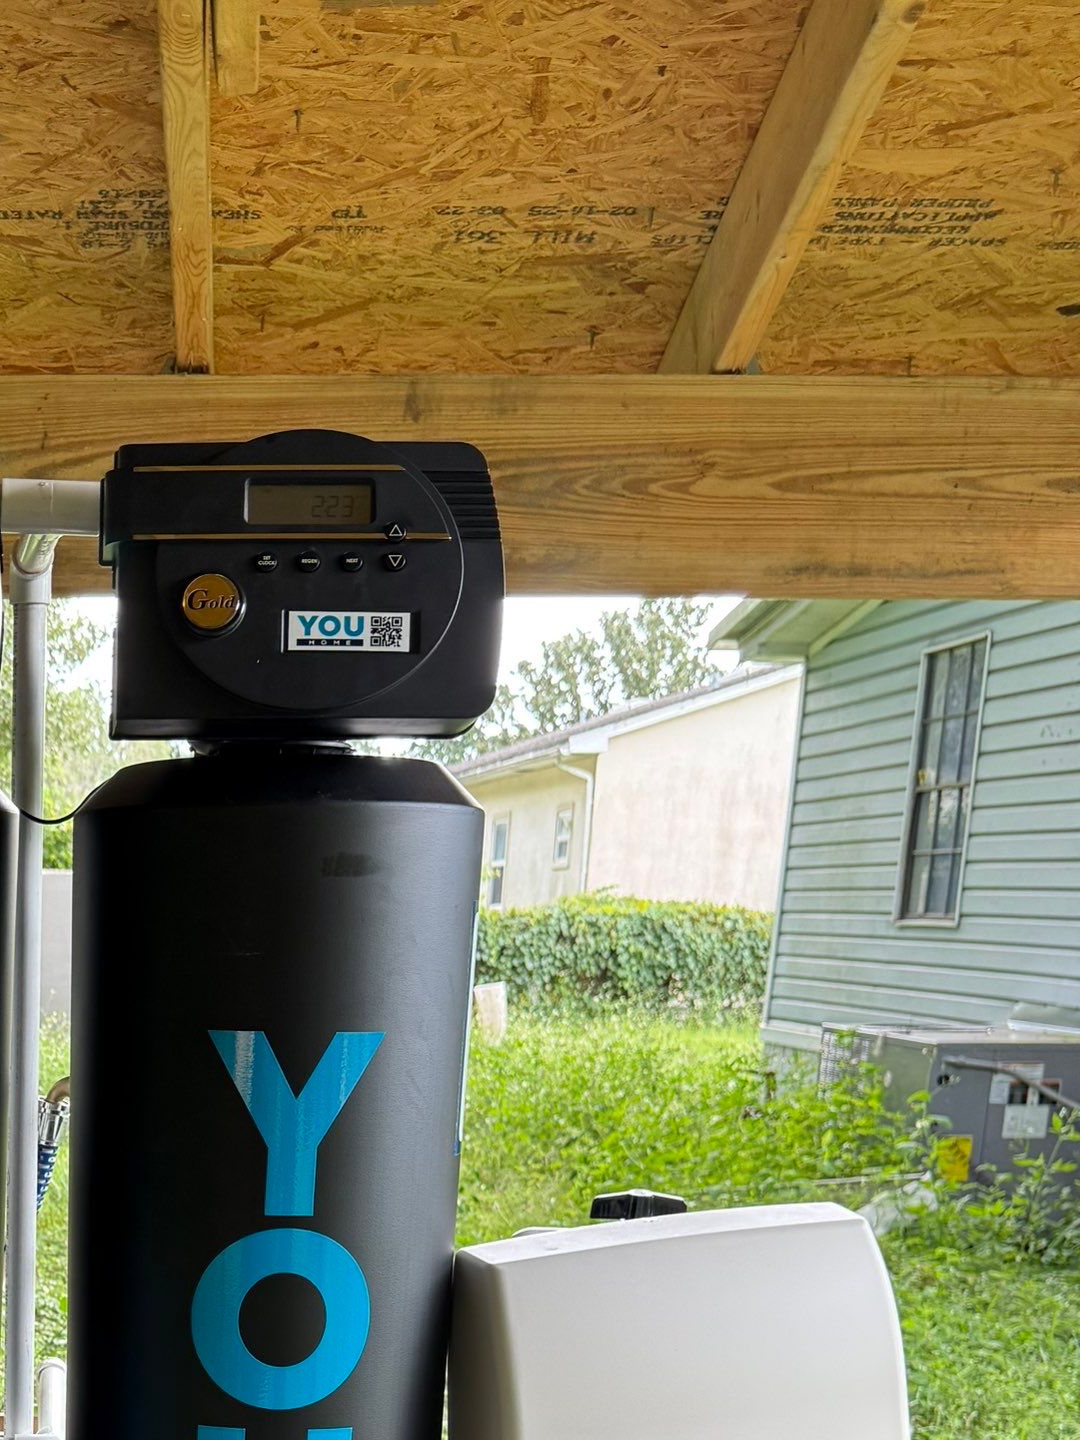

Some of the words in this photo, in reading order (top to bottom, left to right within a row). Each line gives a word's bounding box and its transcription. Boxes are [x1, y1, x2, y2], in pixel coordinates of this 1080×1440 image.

[523, 230, 597, 245] MILL
[187, 588, 235, 610] Gold
[296, 615, 366, 637] YOU
